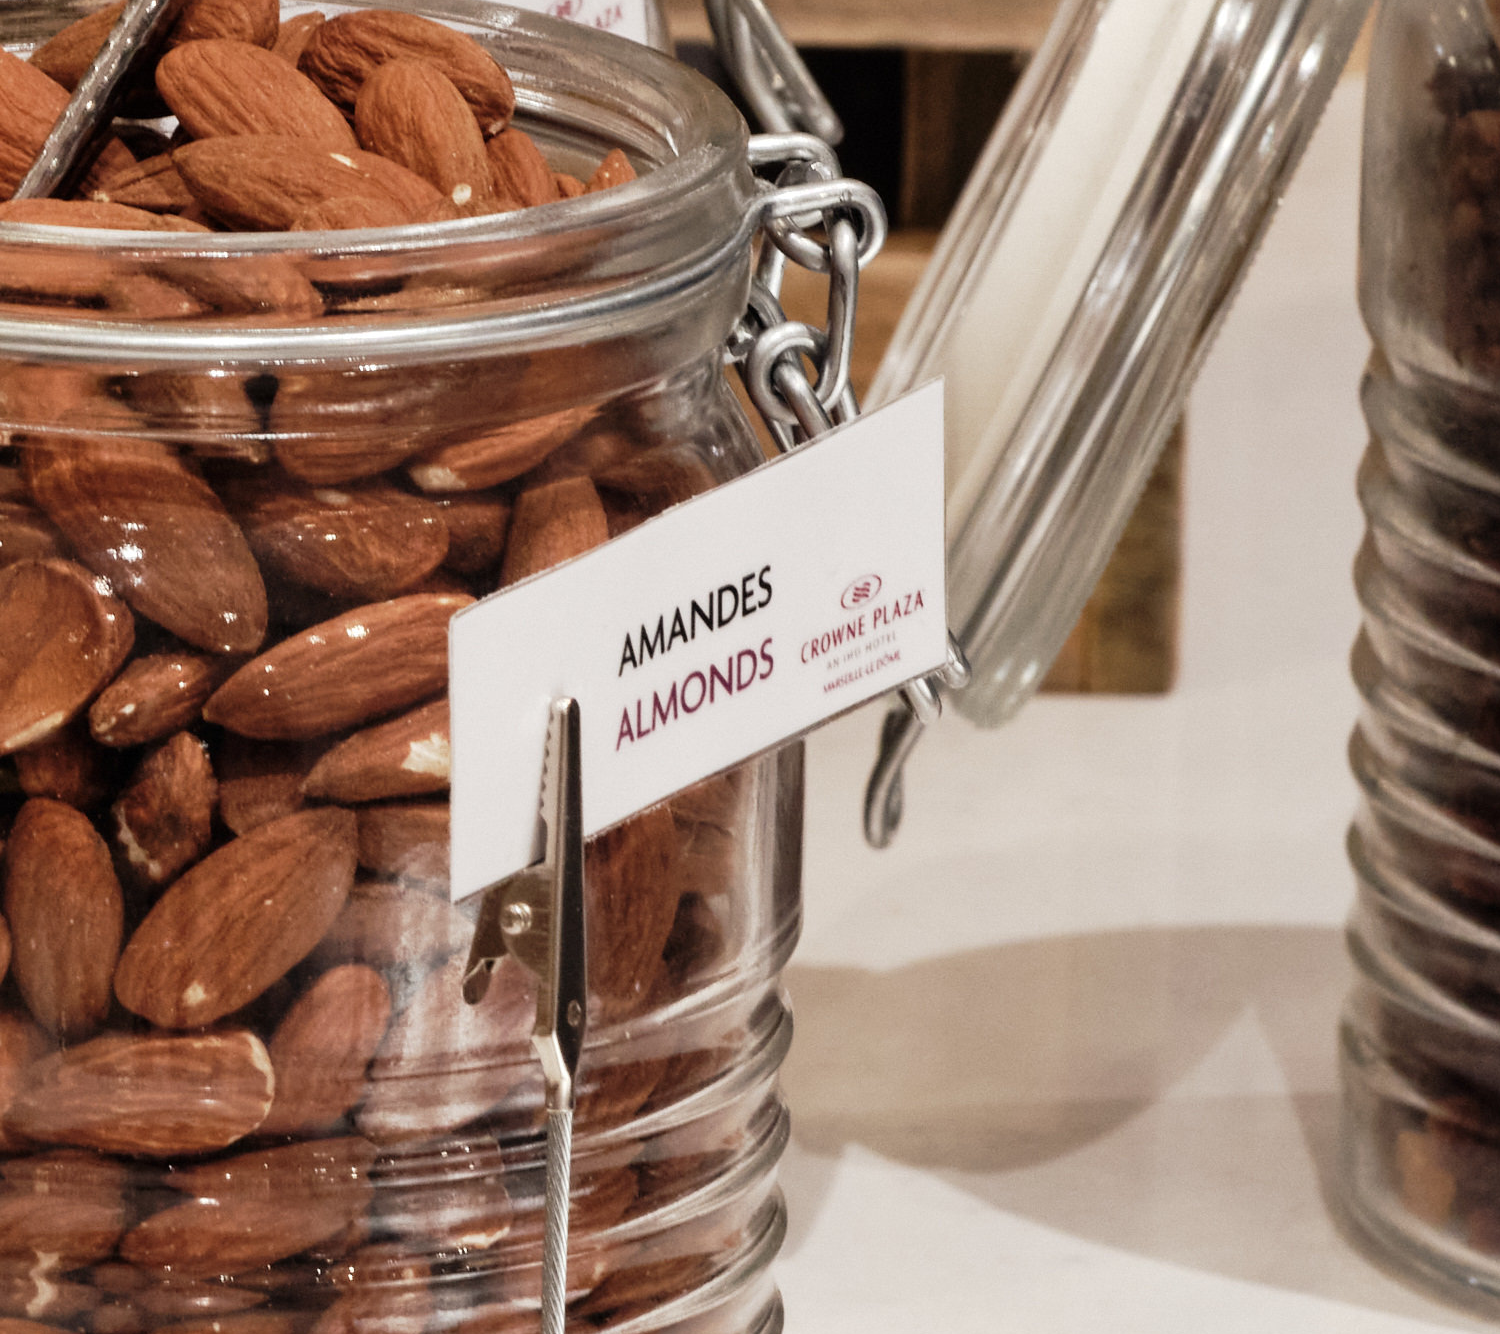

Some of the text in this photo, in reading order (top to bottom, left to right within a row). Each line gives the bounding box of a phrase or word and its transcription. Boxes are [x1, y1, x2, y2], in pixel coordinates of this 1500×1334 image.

[618, 565, 772, 677] AMANDES
[801, 590, 924, 664] CROWNE PLAZA
[616, 637, 774, 751] ALMONDS
